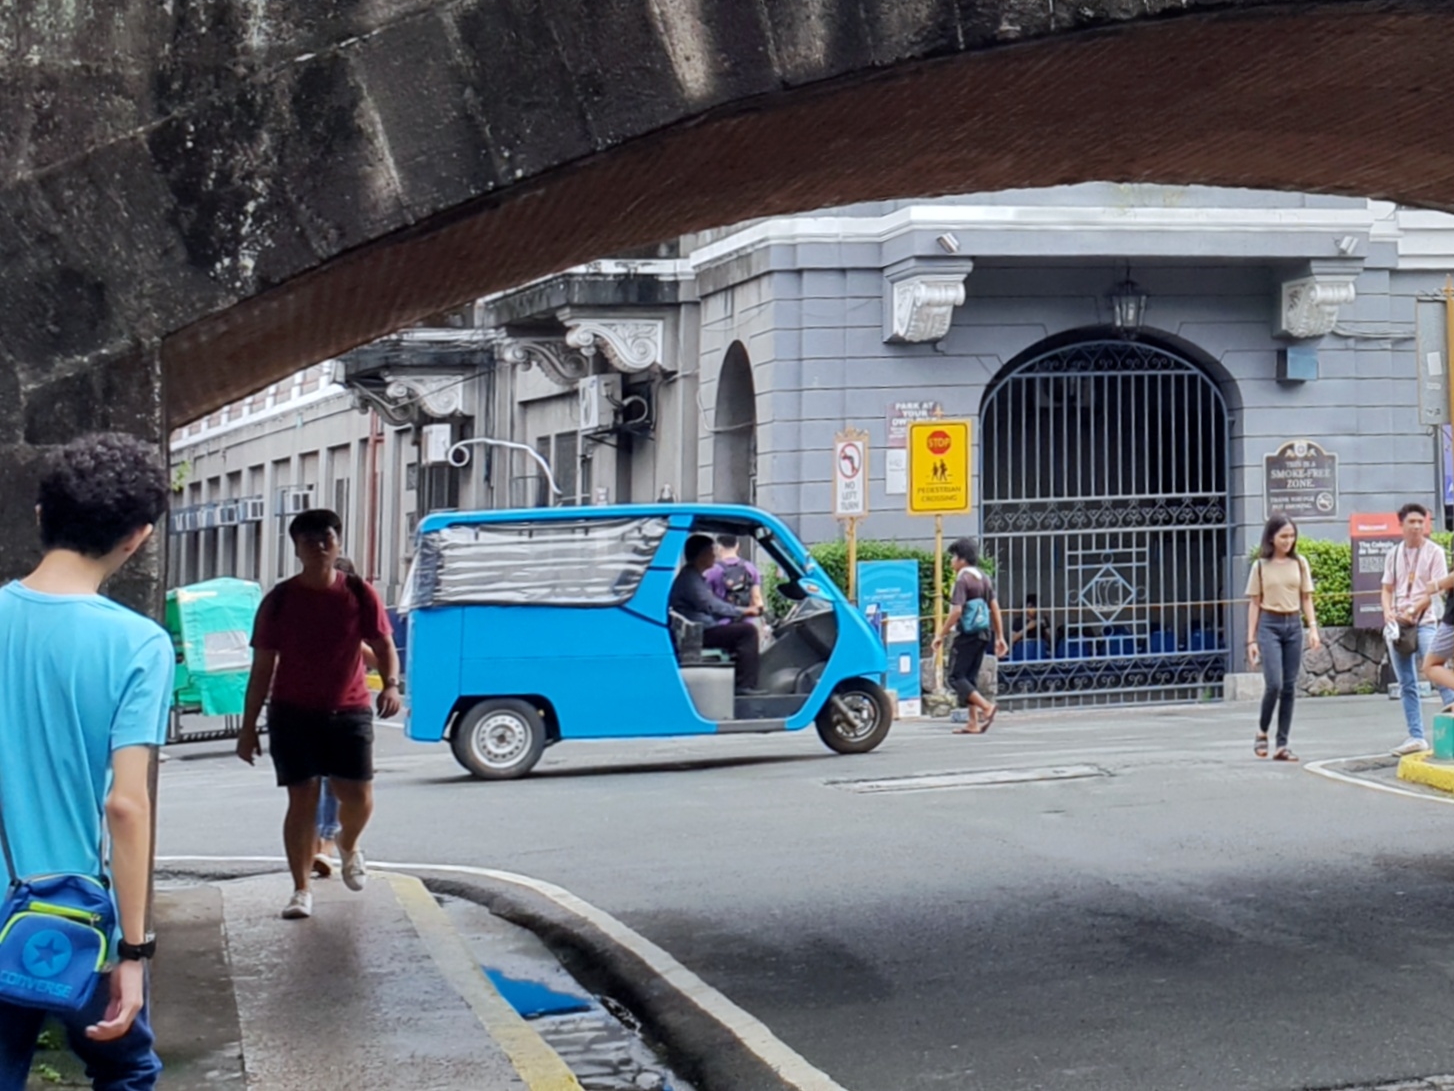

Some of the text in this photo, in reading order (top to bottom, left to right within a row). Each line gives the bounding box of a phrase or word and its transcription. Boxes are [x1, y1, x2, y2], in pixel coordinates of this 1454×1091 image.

[895, 401, 935, 411] PARK AT
[928, 437, 950, 448] STOP
[1270, 468, 1331, 479] SMOKE-FREE
[844, 481, 855, 490] NO
[917, 485, 962, 494] PEDESTRIAN
[841, 491, 857, 501] LEFT
[921, 494, 957, 502] CROSSING
[840, 501, 860, 510] TURN
[0, 969, 73, 999] CONVERSE
